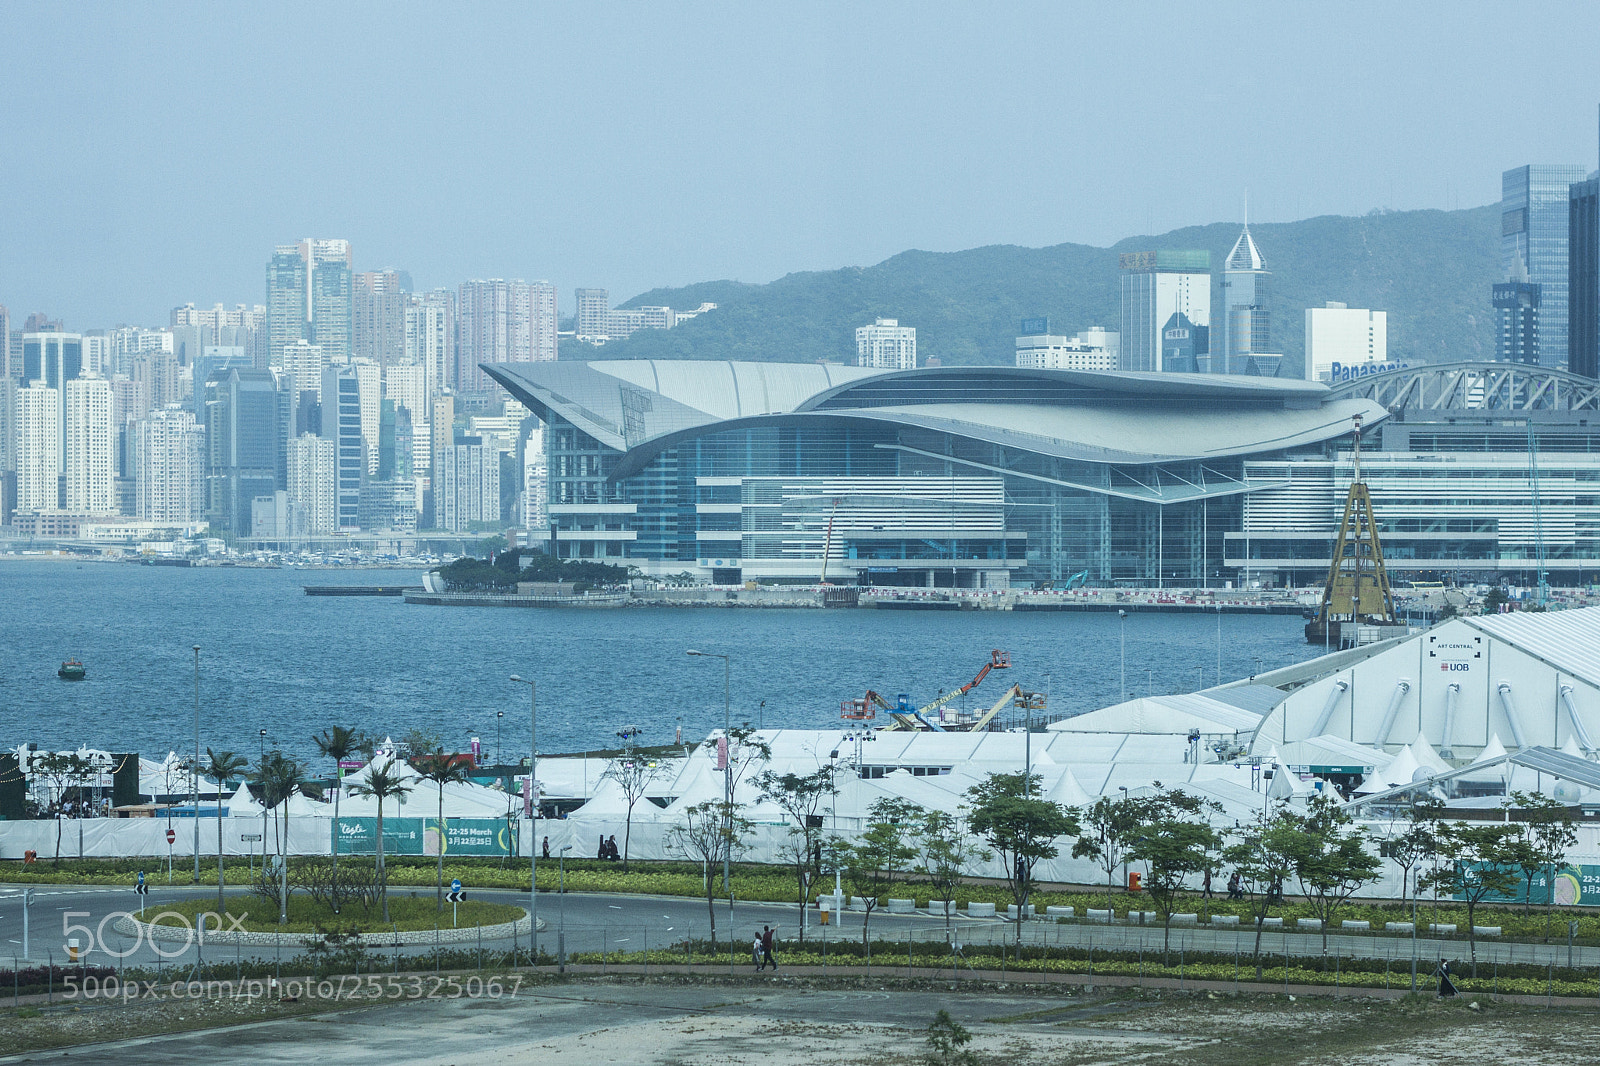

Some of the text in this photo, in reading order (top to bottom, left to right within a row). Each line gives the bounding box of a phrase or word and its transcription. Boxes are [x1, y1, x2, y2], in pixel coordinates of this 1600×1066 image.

[1450, 663, 1469, 671] UOB
[934, 689, 961, 707] RENTALS
[448, 837, 492, 846] 3月22至25日
